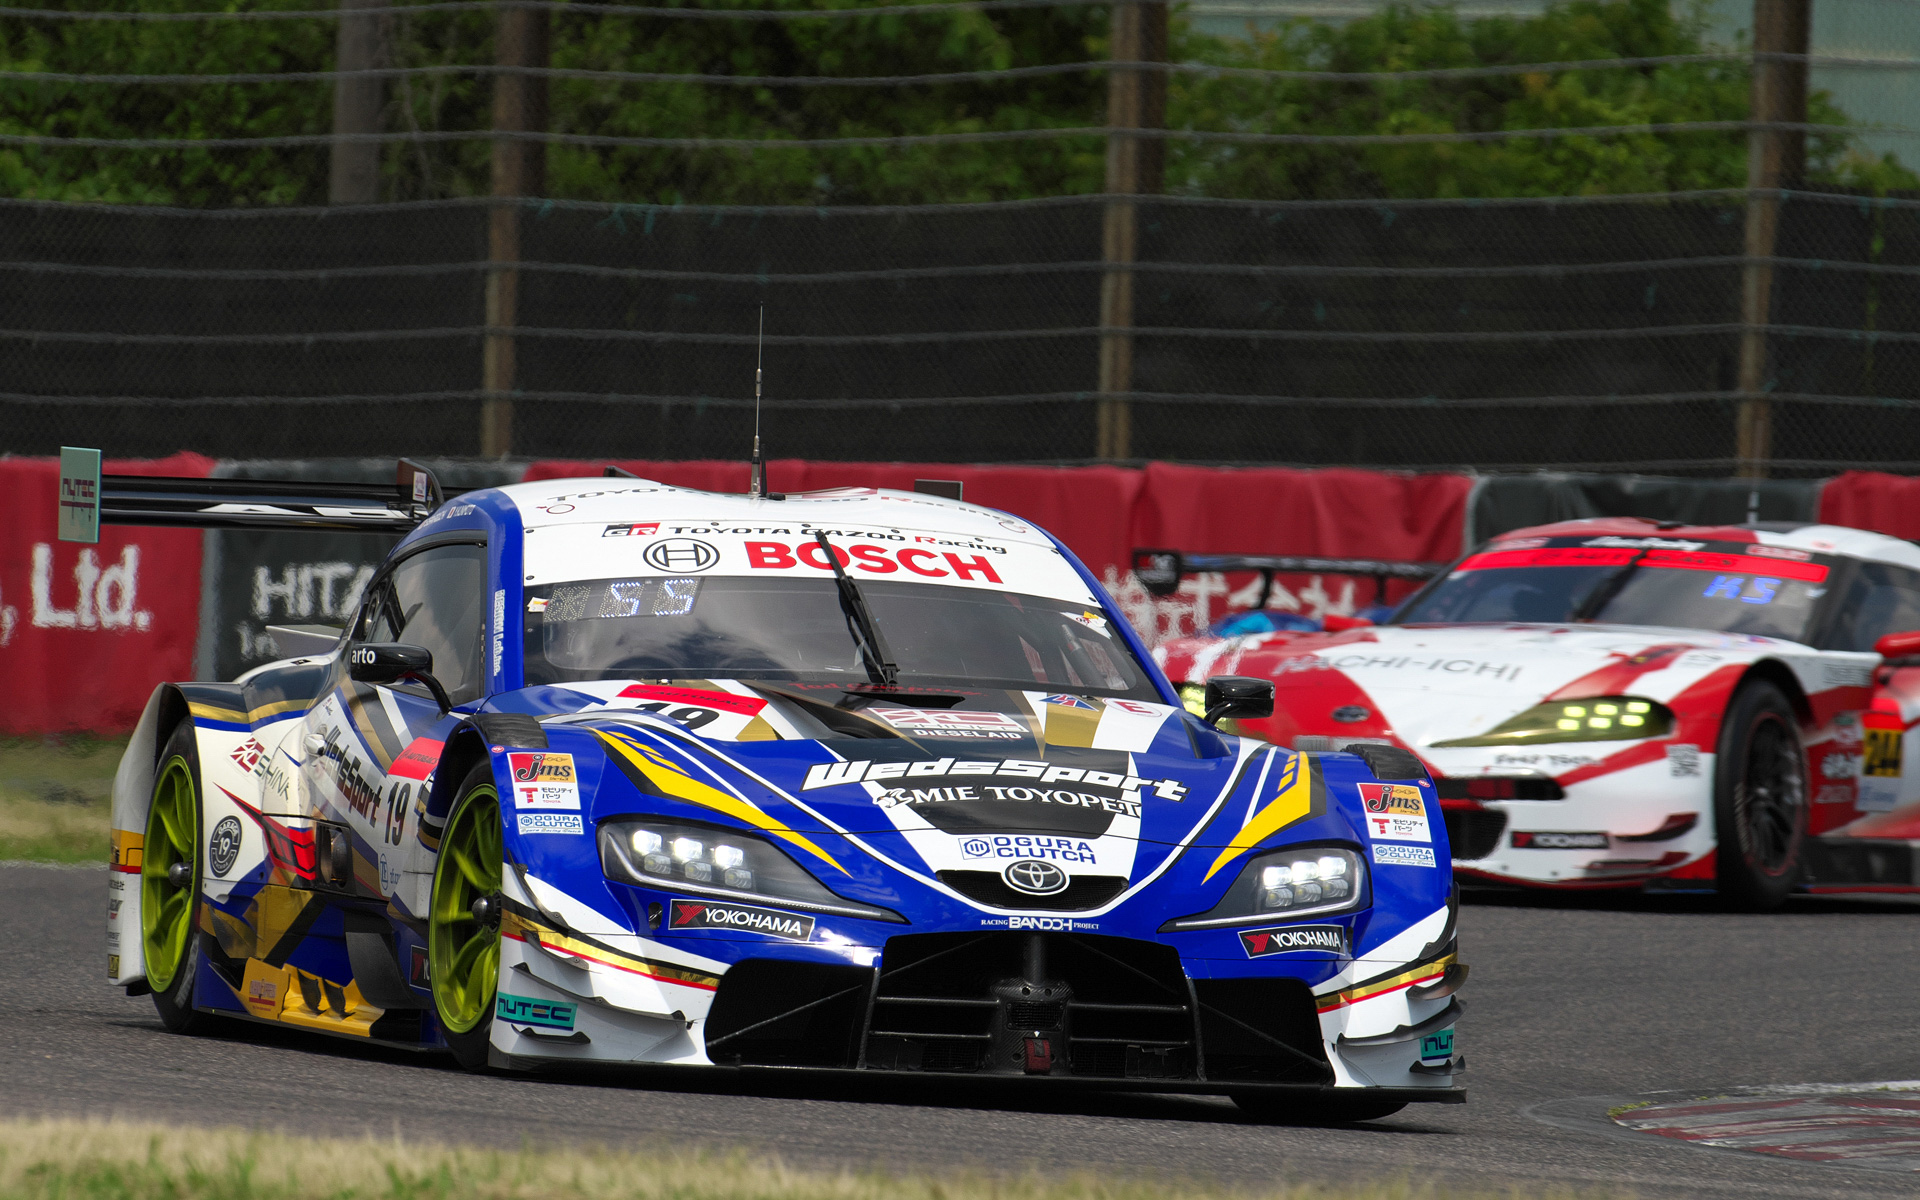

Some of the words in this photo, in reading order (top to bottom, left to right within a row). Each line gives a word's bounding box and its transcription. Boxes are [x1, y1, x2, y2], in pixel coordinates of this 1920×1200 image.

[669, 526, 791, 535] TOYOTA
[800, 528, 906, 541] GAZOO
[915, 535, 1007, 555] Racing
[744, 541, 1004, 584] BOSCH
[32, 543, 153, 630] Ltd.
[351, 648, 376, 664] arto
[634, 702, 720, 731] 19
[1865, 731, 1902, 775] 244
[801, 757, 1190, 802] WedsSport
[384, 781, 411, 846] 19
[913, 786, 980, 804] MIE
[985, 786, 1141, 818] TOYOPET
[218, 837, 230, 855] 19
[994, 837, 1094, 853] OGURA
[996, 846, 1097, 864] CLUTCH
[1388, 846, 1432, 855] OGURA
[1389, 852, 1433, 861] CLUTCH
[704, 907, 802, 936] YOKOHAMA
[1008, 916, 1073, 931] BANDOH
[1074, 922, 1099, 930] PROJECT
[1270, 930, 1342, 948] YOKOHAMA
